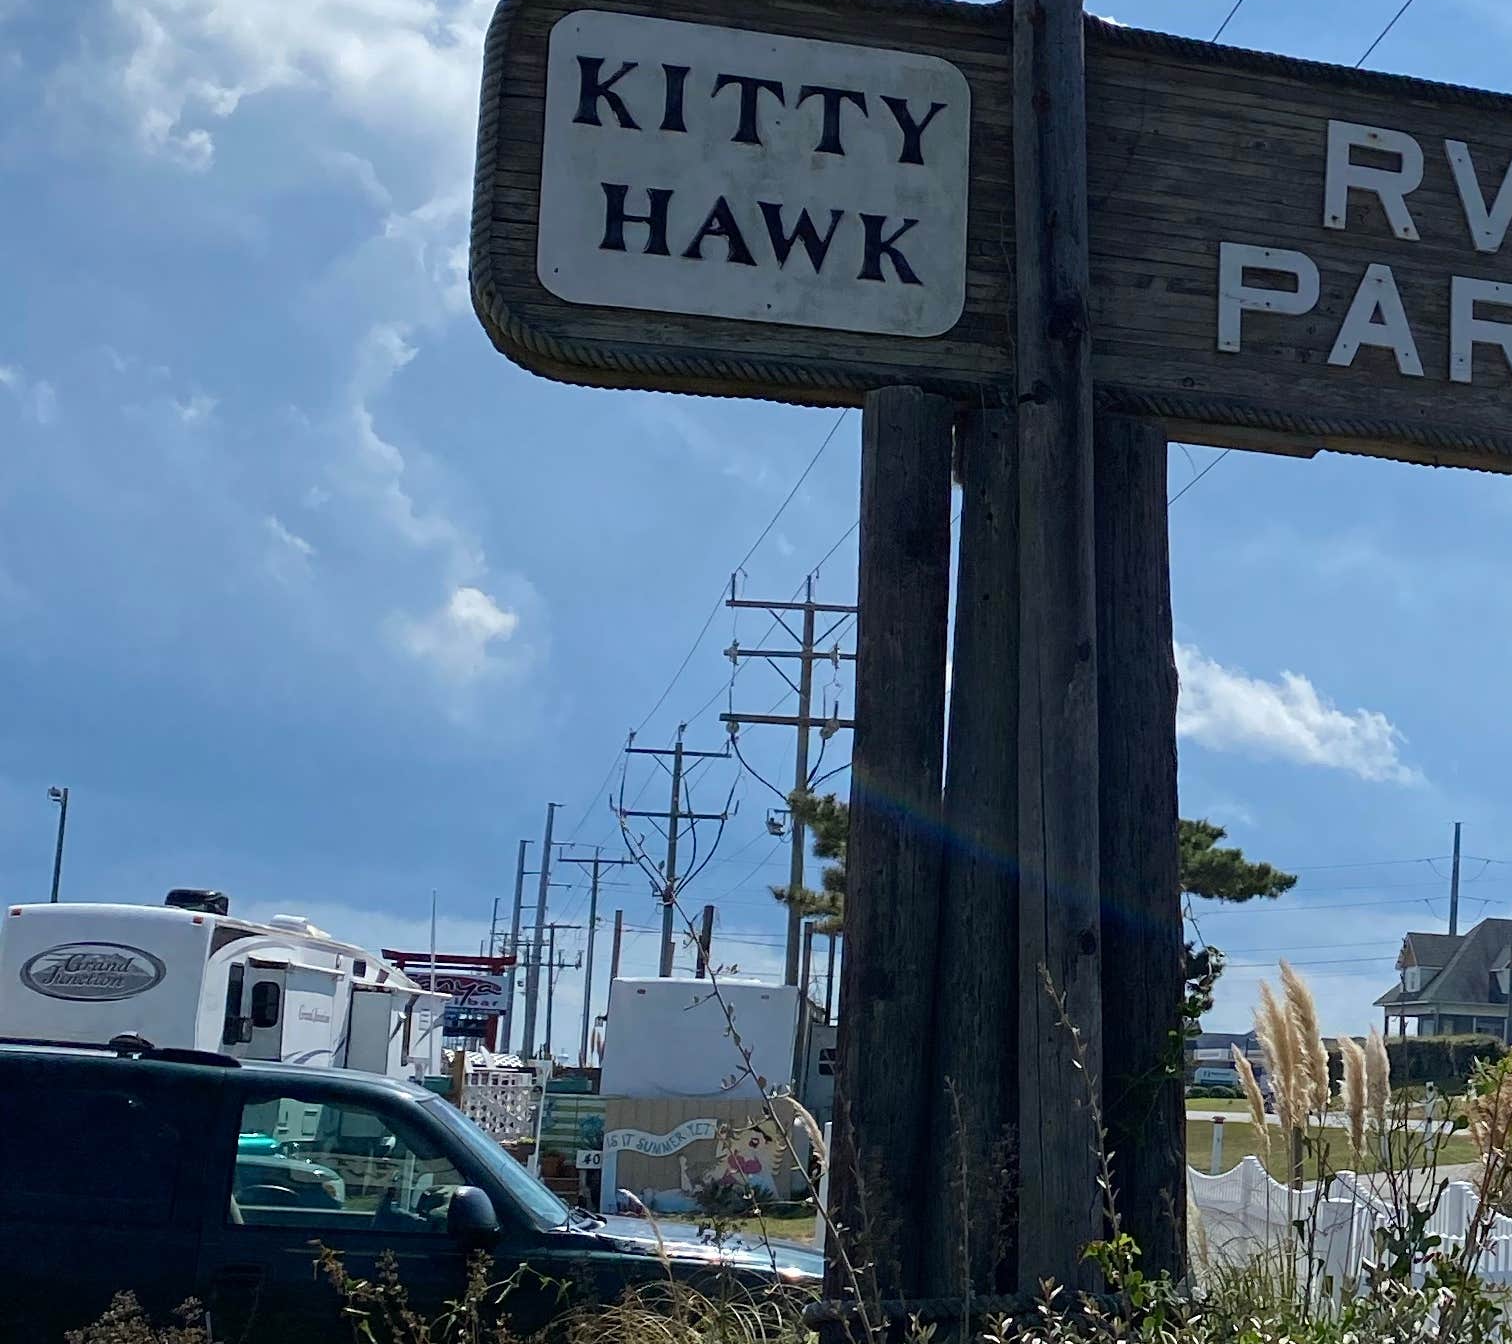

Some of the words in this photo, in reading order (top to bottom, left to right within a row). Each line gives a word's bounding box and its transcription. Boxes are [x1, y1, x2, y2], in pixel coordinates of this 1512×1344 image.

[572, 54, 949, 166] KITTY
[598, 181, 925, 287] HAWK
[42, 964, 126, 988] Junction
[64, 953, 136, 973] Grand
[606, 1134, 619, 1148] IS
[621, 1133, 635, 1147] IT
[636, 1130, 687, 1155] SUMMER
[686, 1122, 712, 1137] YET
